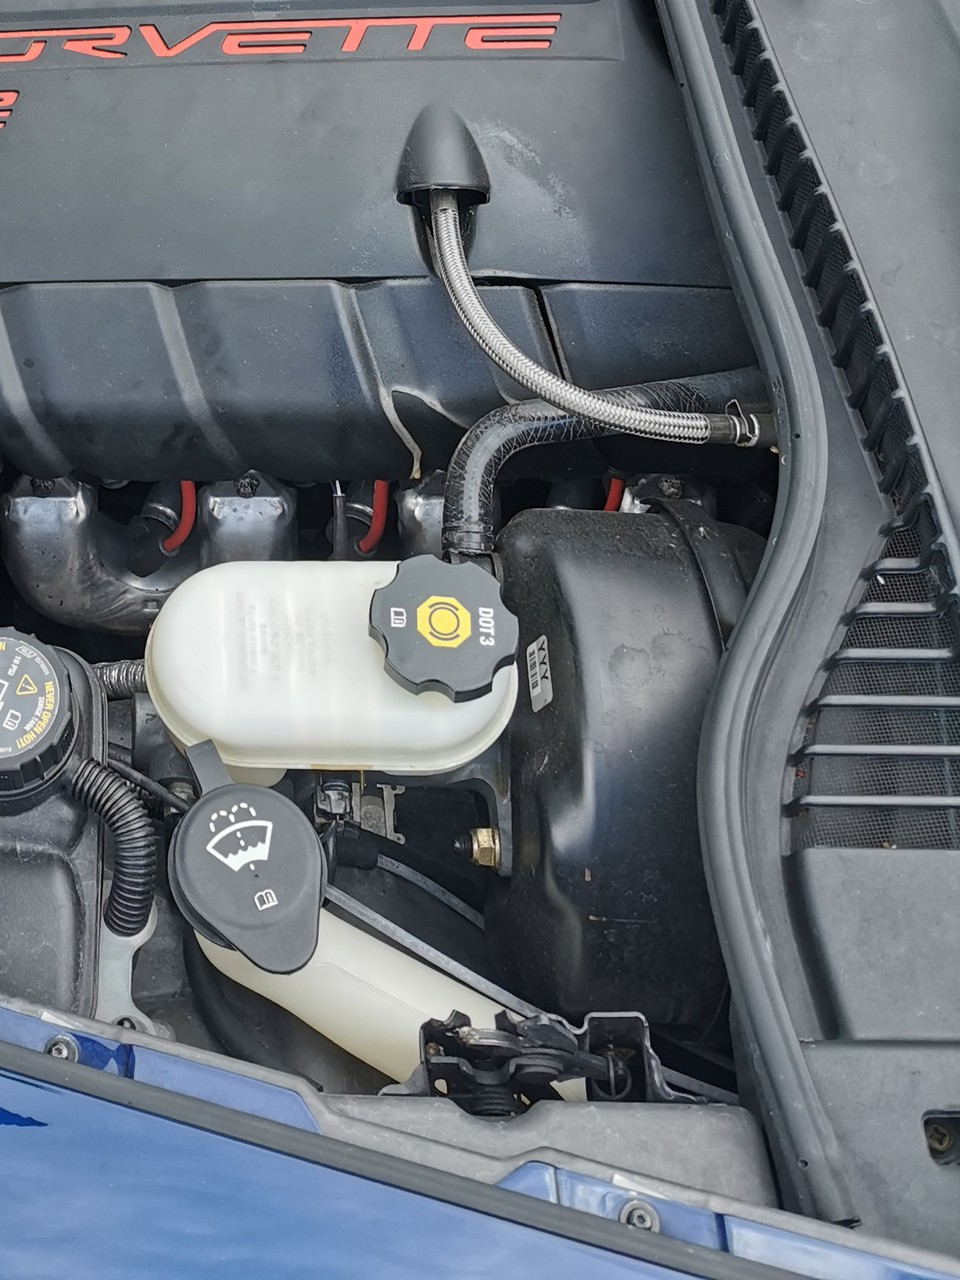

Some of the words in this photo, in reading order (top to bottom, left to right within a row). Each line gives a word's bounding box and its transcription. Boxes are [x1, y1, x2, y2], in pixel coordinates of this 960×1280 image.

[478, 606, 494, 636] DOT
[479, 635, 495, 647] 3
[13, 655, 21, 665] 18
[537, 640, 549, 681] YYY
[7, 663, 18, 677] PSI
[44, 681, 55, 711] NEVER
[34, 696, 45, 715] SURGE
[23, 714, 38, 732] TANK
[33, 711, 51, 735] OPEN
[16, 731, 37, 749] HOT!
